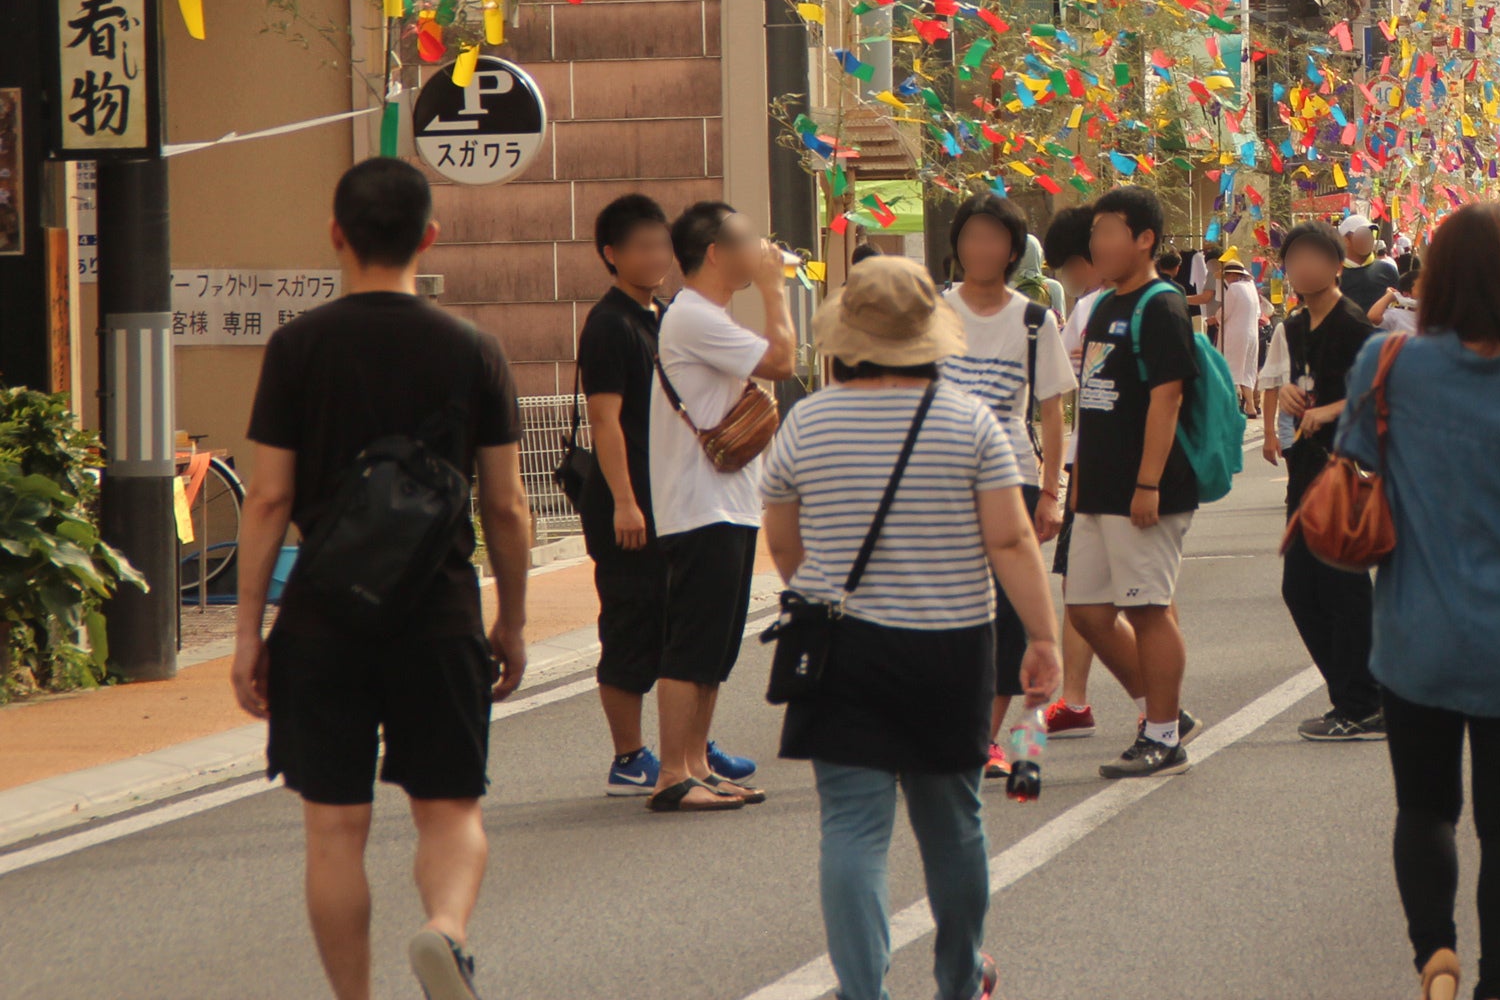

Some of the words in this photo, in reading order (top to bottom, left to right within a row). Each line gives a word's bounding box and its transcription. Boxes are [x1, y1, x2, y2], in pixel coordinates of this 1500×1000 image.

[458, 69, 514, 115] P
[437, 140, 521, 169] スガワラ
[170, 273, 335, 299] ーファクトリースガワラ
[172, 310, 208, 336] 客様
[223, 311, 262, 336] 専用
